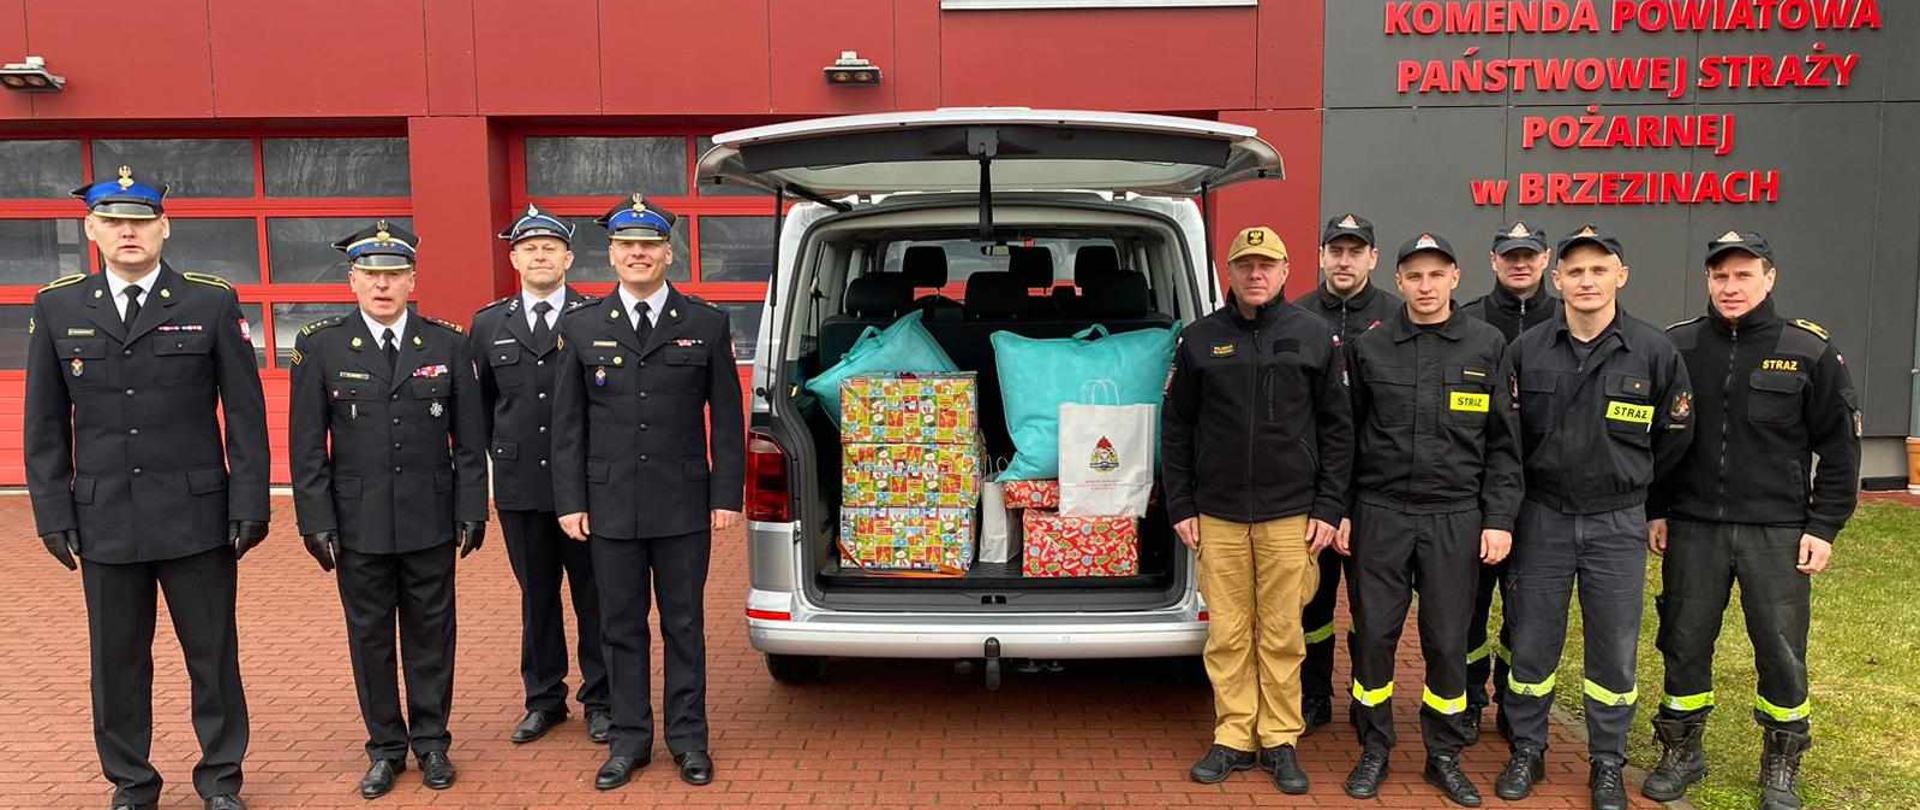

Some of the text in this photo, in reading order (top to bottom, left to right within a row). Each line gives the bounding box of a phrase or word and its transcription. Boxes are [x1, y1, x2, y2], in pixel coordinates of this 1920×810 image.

[1384, 0, 1882, 34] KOMENDA POWIATOWA
[1397, 41, 1860, 98] PAŃSTWOWEJ STRAŻY
[1522, 105, 1735, 154] POŻARNEJ
[1471, 169, 1780, 205] w BRZEZINACH
